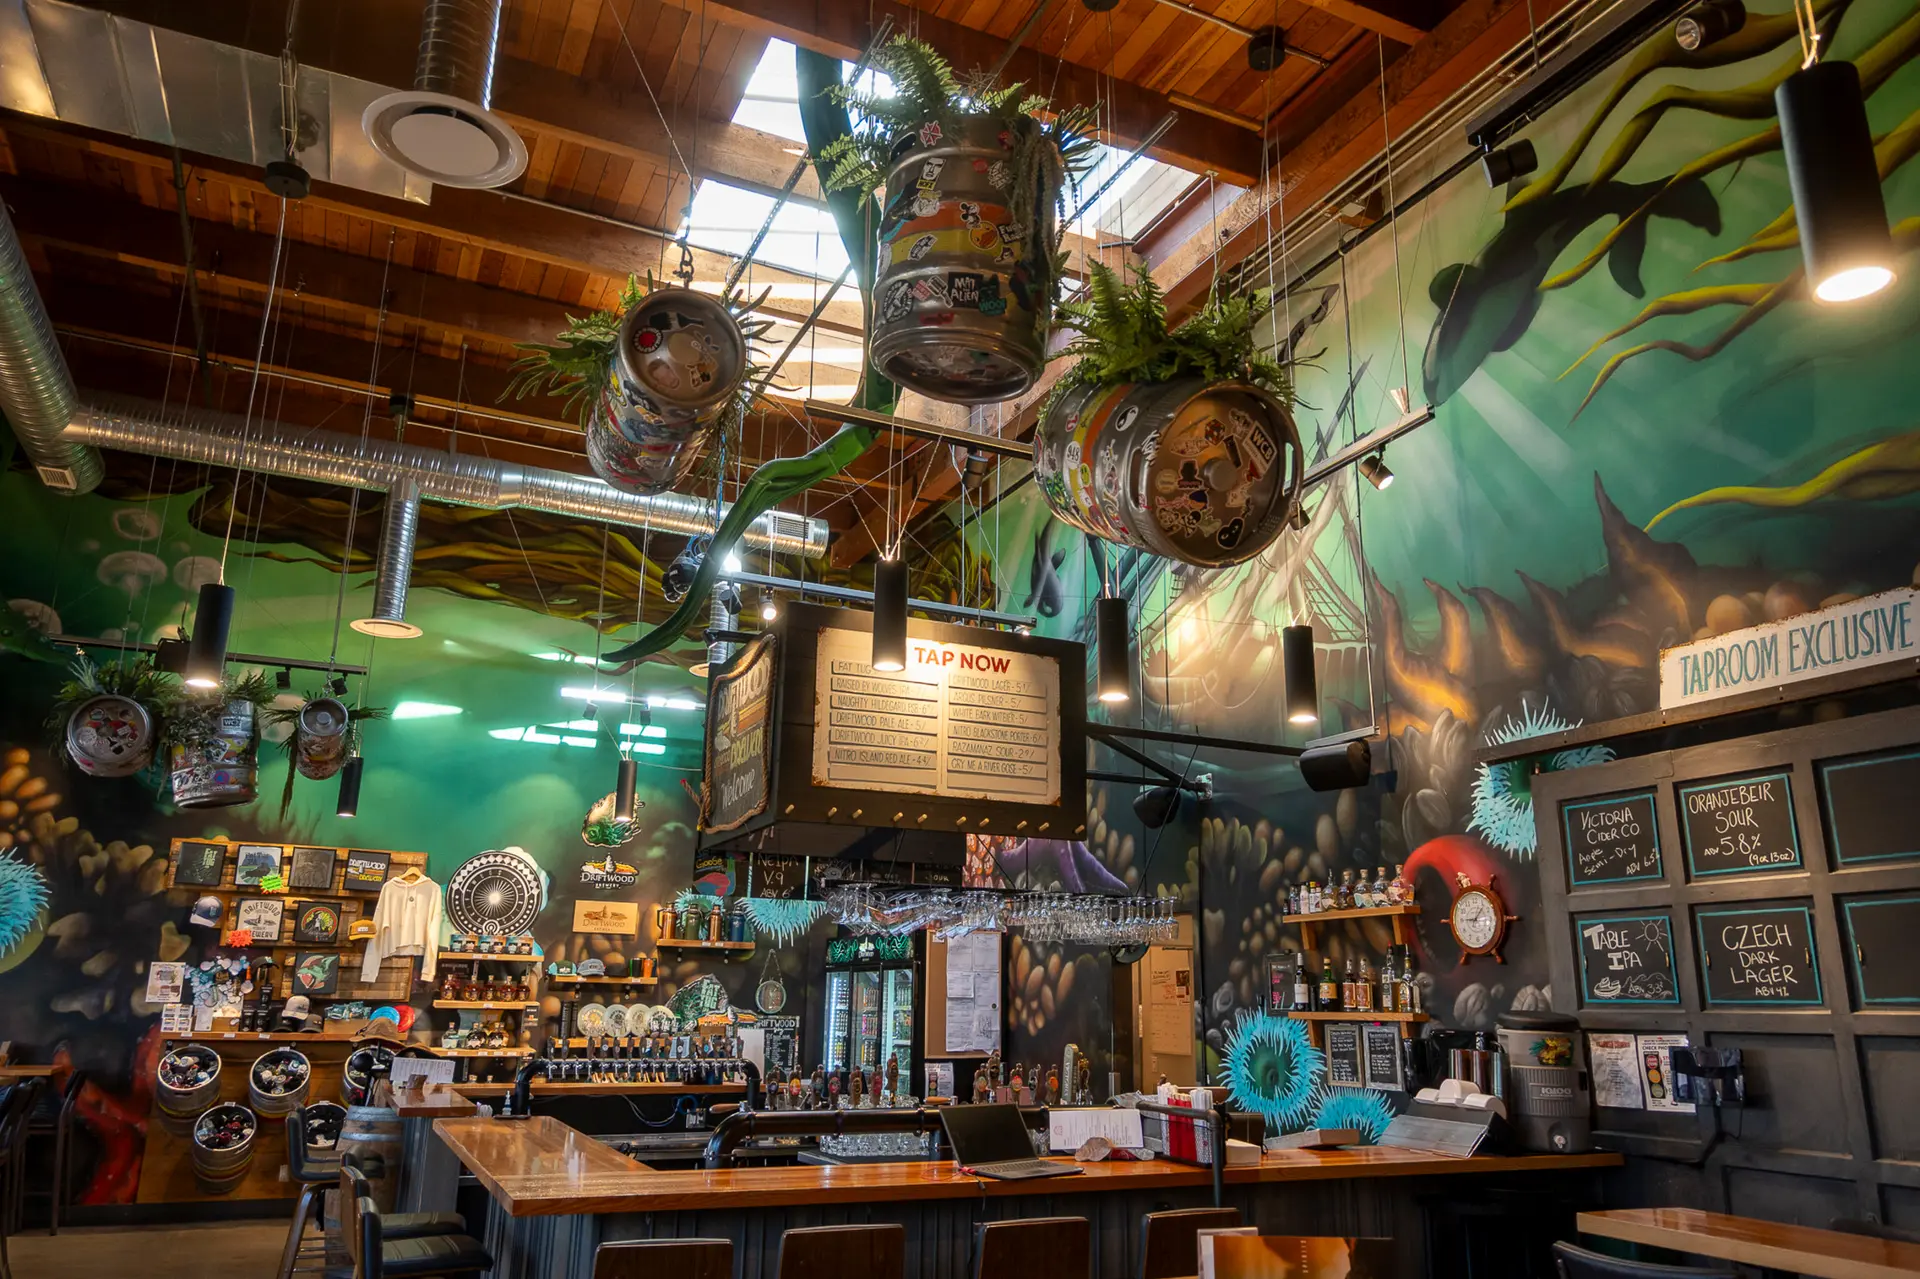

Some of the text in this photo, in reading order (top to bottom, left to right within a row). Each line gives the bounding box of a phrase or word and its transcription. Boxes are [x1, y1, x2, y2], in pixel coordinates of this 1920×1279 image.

[1680, 601, 1914, 697] TAPROOM EXCLUSIVE
[838, 661, 872, 675] FAT TUG
[914, 647, 1011, 674] TAP NOW
[836, 678, 860, 690] RAISED
[871, 682, 898, 694] WOLVES
[837, 696, 869, 708] NAUGHTY
[836, 711, 877, 726] DRIFTWOOD
[880, 716, 895, 729] PALE
[897, 718, 909, 730] ALE
[952, 708, 974, 719] WHITE
[975, 711, 991, 721] BARK
[835, 728, 876, 744] DRIFTWOOD
[877, 732, 897, 745] JUICY
[973, 727, 1009, 741] BLACKSTONE
[1010, 731, 1029, 743] PORTER
[835, 748, 857, 761] NITRO
[860, 750, 884, 763] ISLAND
[885, 753, 898, 764] RED
[899, 754, 911, 765] ALE
[995, 745, 1014, 757] SOUR
[951, 757, 966, 769] CRY
[967, 760, 976, 770] ME
[977, 760, 983, 771] A
[984, 761, 1001, 772] RIVER
[1001, 763, 1017, 775] GOSE
[721, 768, 755, 809] Welcome
[1689, 782, 1775, 815] ORANJEBEIR
[1581, 807, 1634, 831] VICTORIA
[1715, 807, 1760, 834] SOUR
[1586, 823, 1641, 845] CIDER CO
[348, 859, 387, 870] DRIFTWOOD
[580, 872, 635, 884] DRIFTWOOD
[244, 902, 281, 917] DRIFTWOOD
[582, 918, 626, 928] DRIFTWOOD
[1583, 923, 1632, 951] TABLE
[1722, 923, 1793, 951] CZECH
[1607, 950, 1643, 971] IPA
[1739, 950, 1780, 968] DARK
[1730, 965, 1798, 985] LAGER
[758, 1019, 796, 1028] RIFTWOOD
[1541, 1087, 1572, 1096] IGLOO
